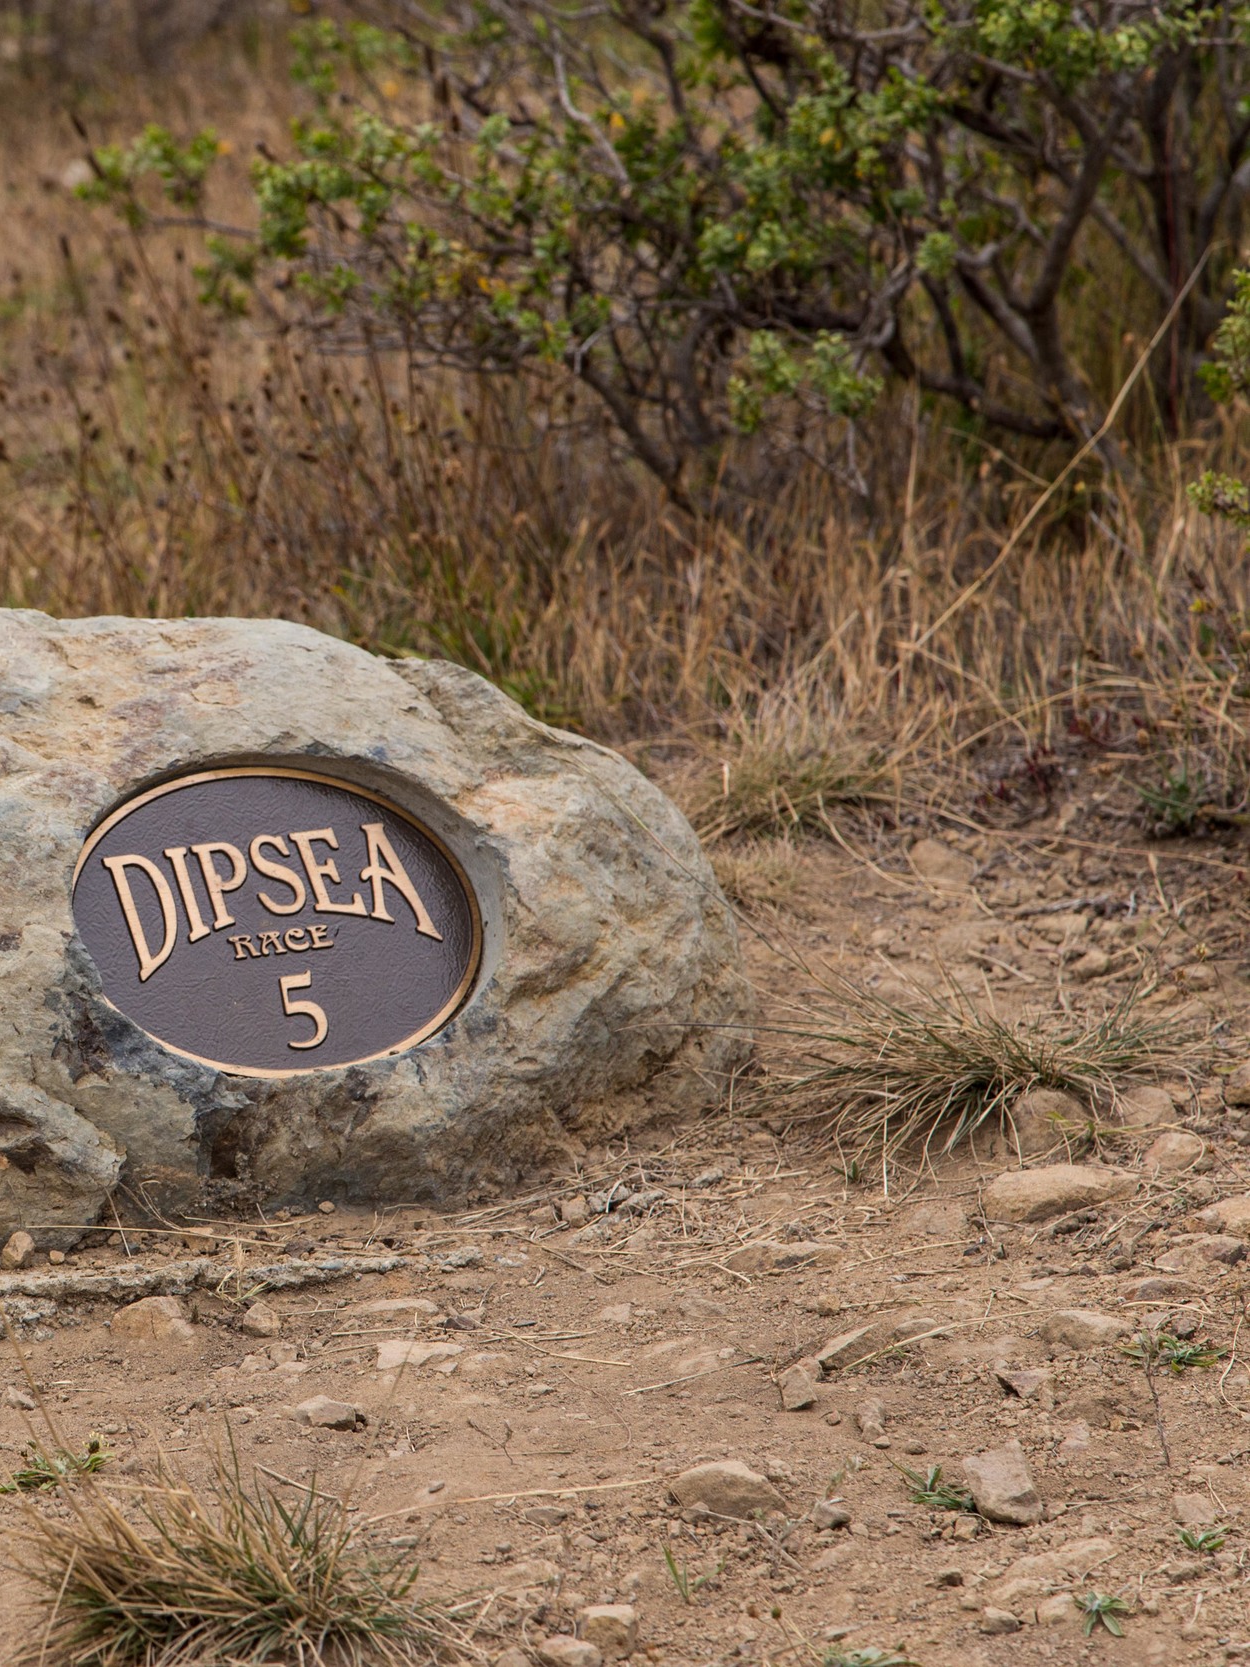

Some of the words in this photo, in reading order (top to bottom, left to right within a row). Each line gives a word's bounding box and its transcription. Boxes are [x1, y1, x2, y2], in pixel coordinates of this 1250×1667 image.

[102, 823, 443, 982] DIPSEA
[228, 924, 334, 960] RACE
[279, 970, 329, 1049] 5
